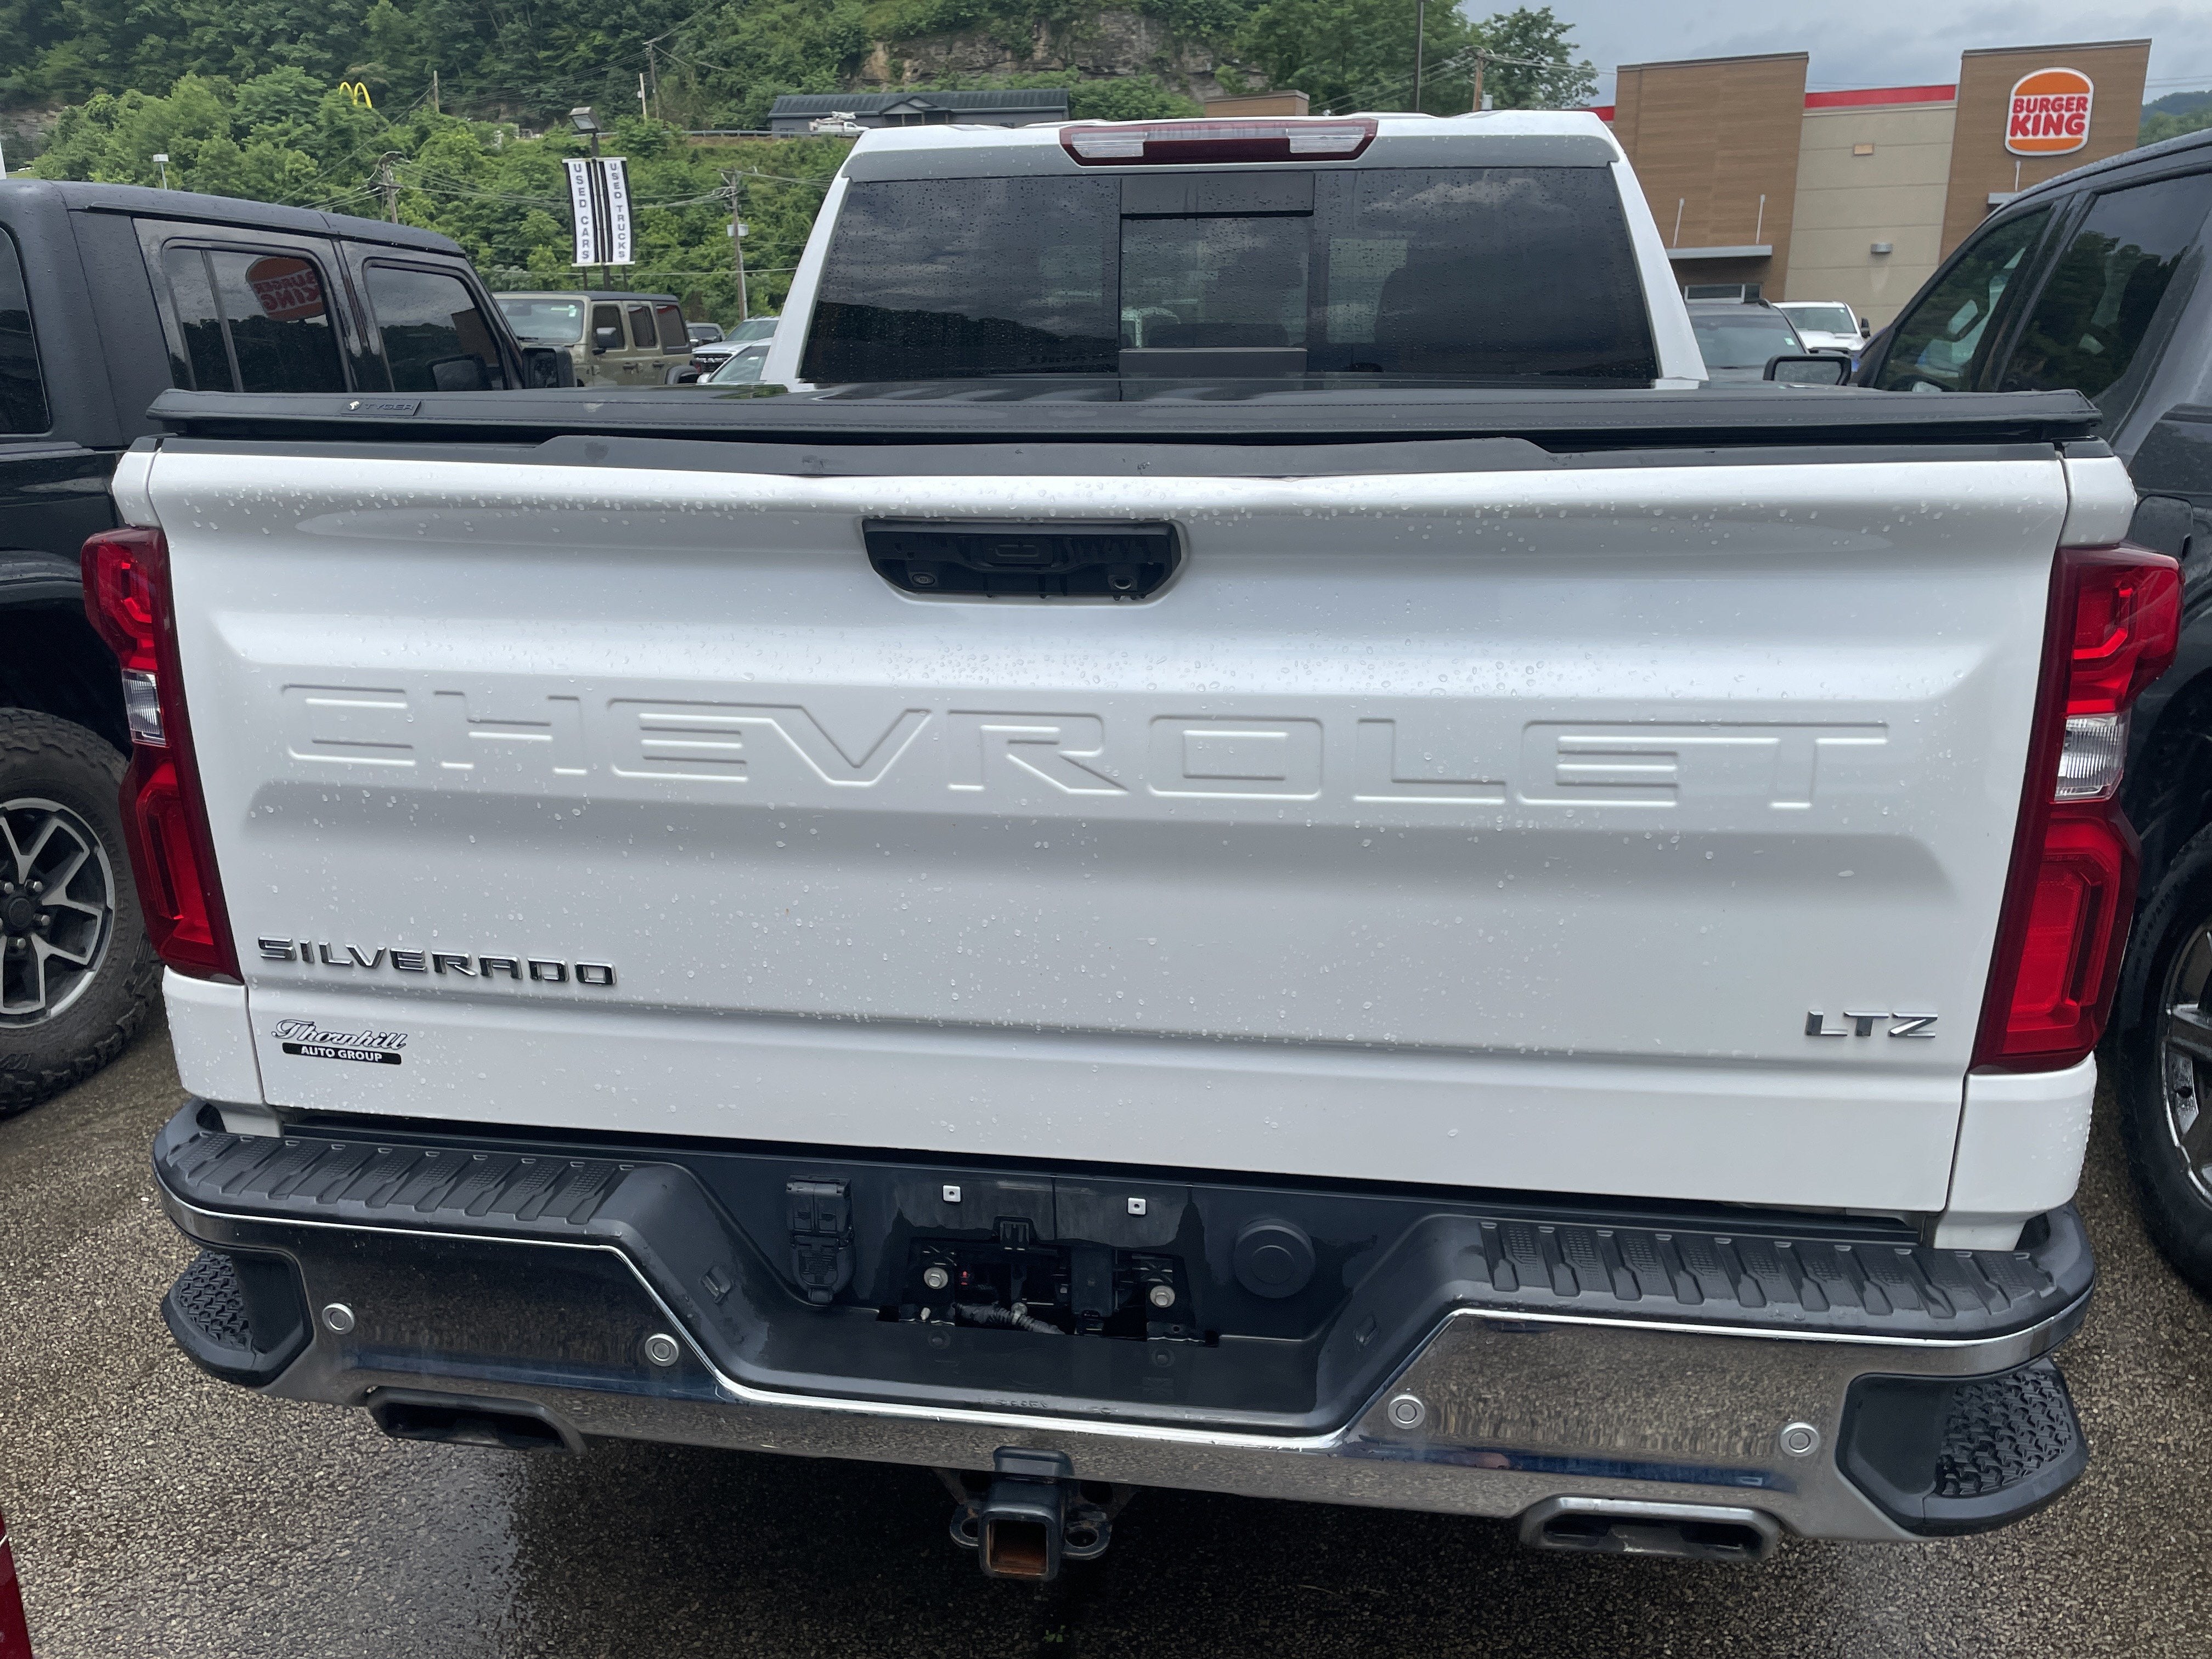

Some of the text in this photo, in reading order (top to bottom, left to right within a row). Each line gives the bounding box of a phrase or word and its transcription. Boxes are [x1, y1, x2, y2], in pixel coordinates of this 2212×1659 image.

[2012, 97, 2089, 114] BURGER
[2010, 113, 2086, 137] KING
[574, 163, 590, 259] USED CARS
[610, 163, 626, 258] USED TRUCKS
[281, 683, 1889, 809] CHEVROLET
[258, 936, 618, 985] SILVERADO
[270, 1019, 408, 1050] Thornhill
[1805, 1009, 1939, 1038] LTZ
[301, 1045, 383, 1063] AUTO GROUP
